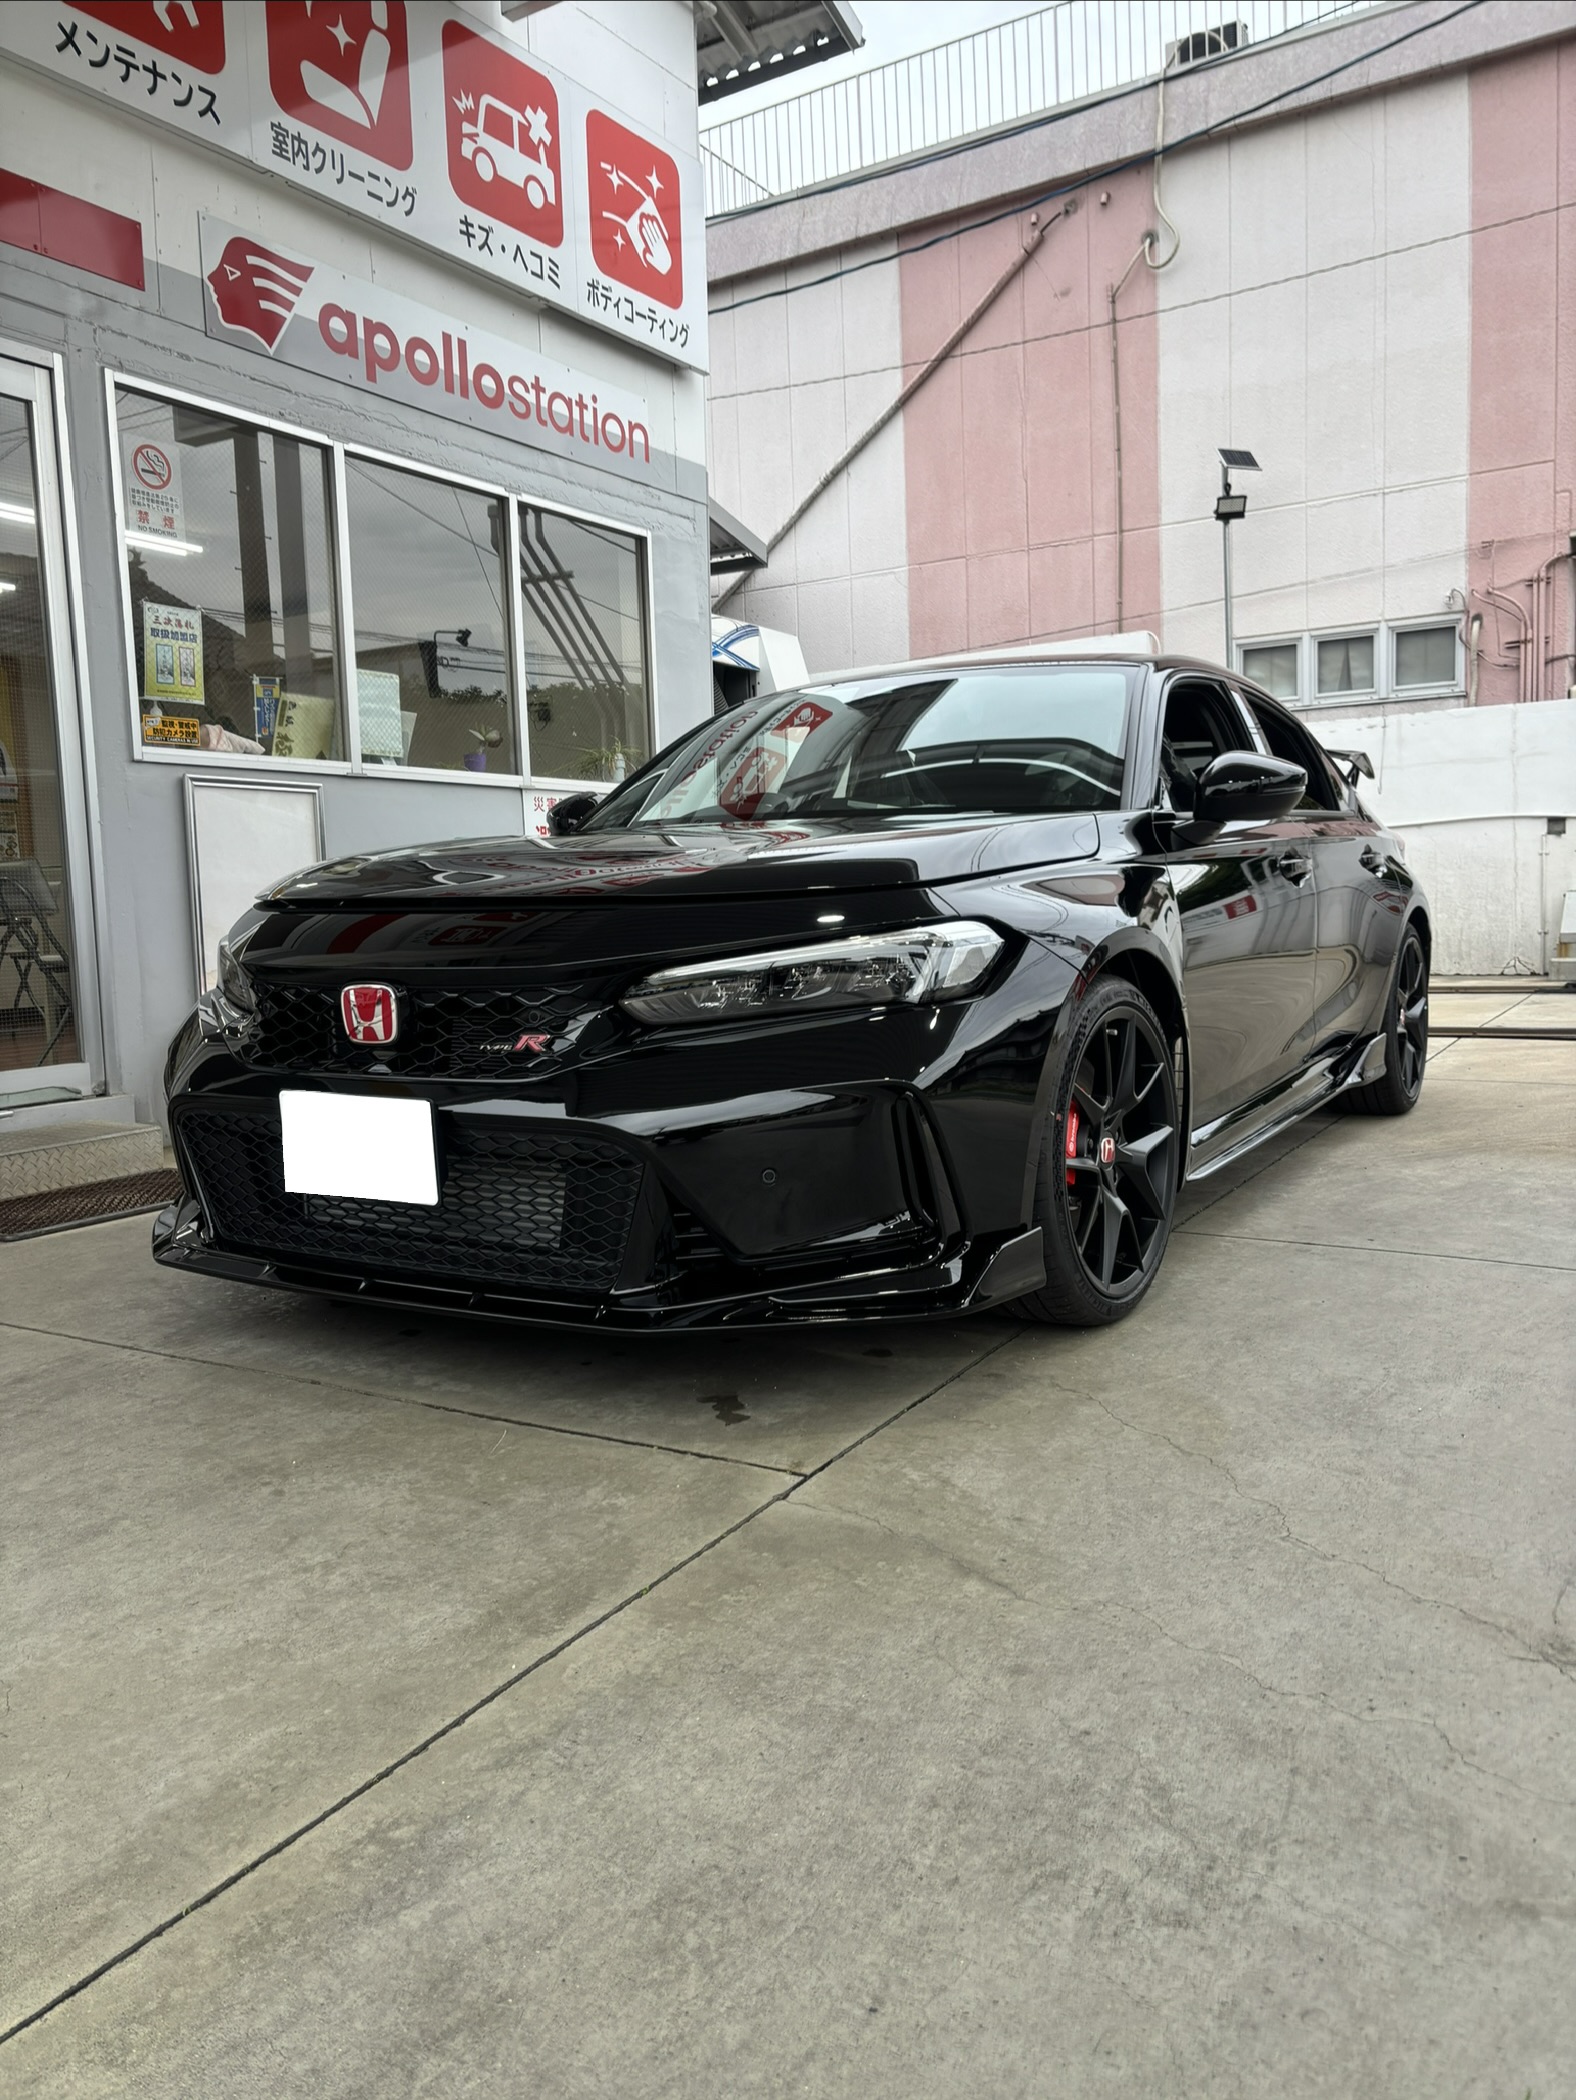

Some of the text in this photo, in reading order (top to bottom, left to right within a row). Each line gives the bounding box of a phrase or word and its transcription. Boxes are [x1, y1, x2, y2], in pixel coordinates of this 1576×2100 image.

[54, 20, 222, 126] メンテナンス
[270, 120, 418, 217] 室内クリーニング
[458, 214, 561, 290] キズ・ヘコミ
[586, 278, 690, 350] ボディコーティング
[318, 301, 651, 464] apollostation
[138, 524, 178, 538] NO SMOKING
[150, 627, 198, 643] 取扱加盟店
[152, 727, 197, 738] 防犯カメラ設置
[513, 1033, 551, 1053] R
